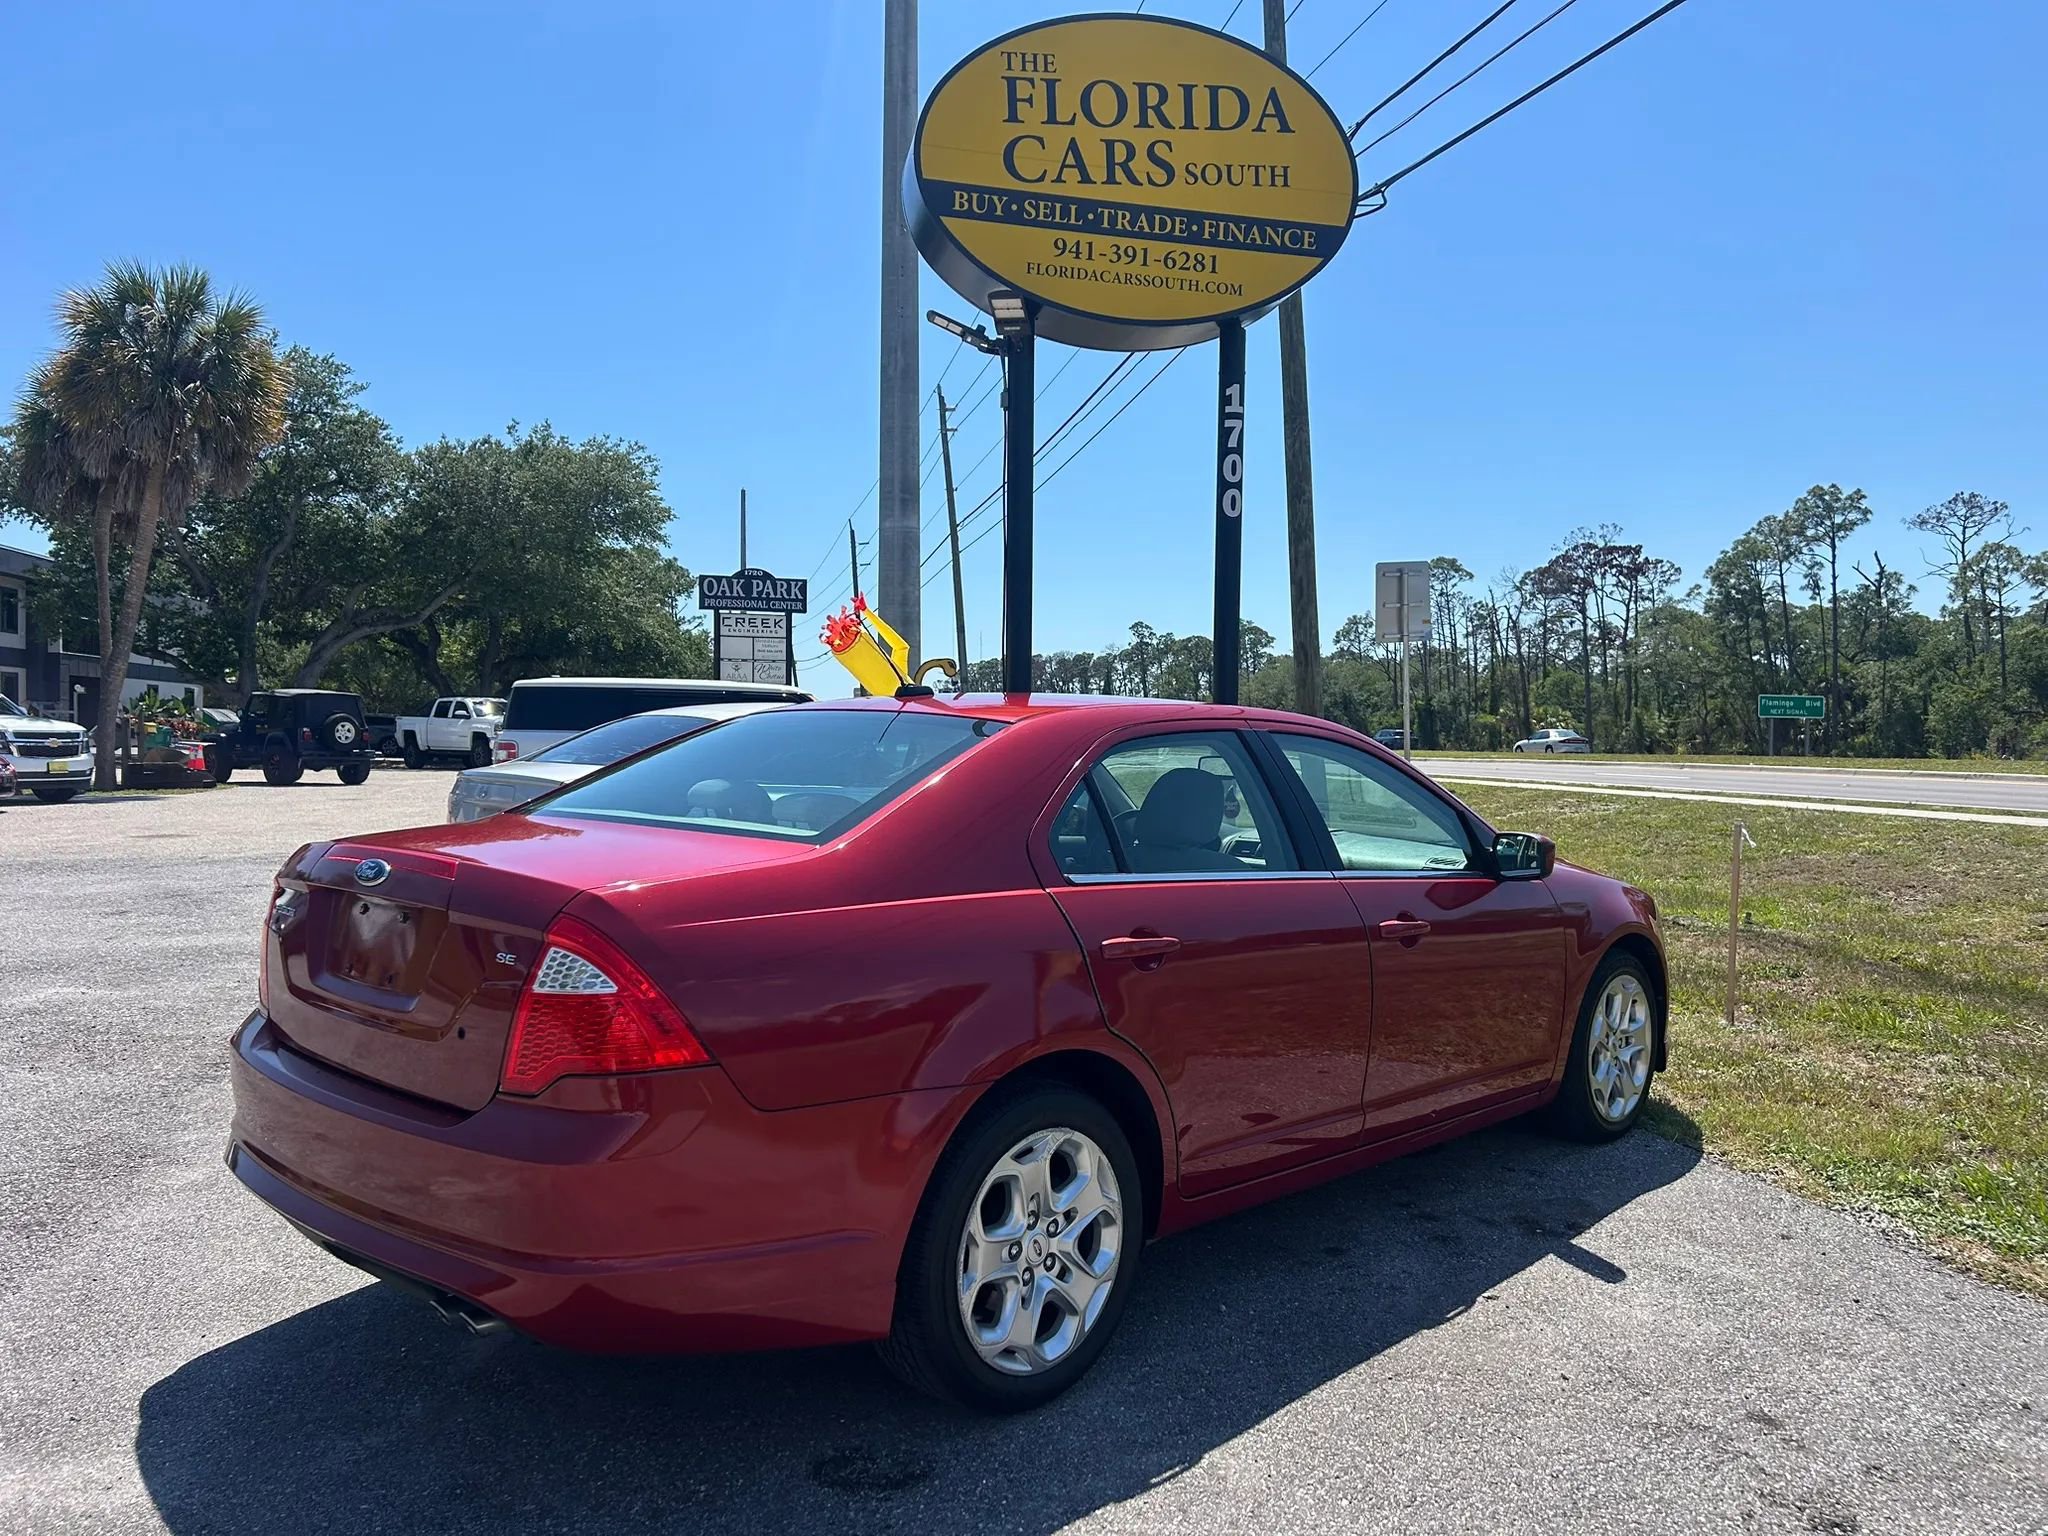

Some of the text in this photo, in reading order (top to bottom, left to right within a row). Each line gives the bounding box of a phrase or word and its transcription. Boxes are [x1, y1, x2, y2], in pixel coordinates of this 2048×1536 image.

[1000, 50, 1057, 74] THE
[1001, 75, 1295, 134] FLORIDA
[1002, 134, 1291, 188] CARS SOUTH
[953, 190, 1317, 250] BUY SELL TRADE FINANCE
[1052, 237, 1219, 275] 941-391-6281
[1026, 262, 1243, 297] FLORIDACARSSOUTH.COM
[1222, 383, 1244, 518] 1700
[702, 577, 804, 600] OAK PARK
[704, 598, 803, 610] PROFESSIONAL CENTER
[721, 616, 784, 630] CREEK
[1761, 699, 1794, 708] Flamingo
[495, 952, 517, 966] SE
